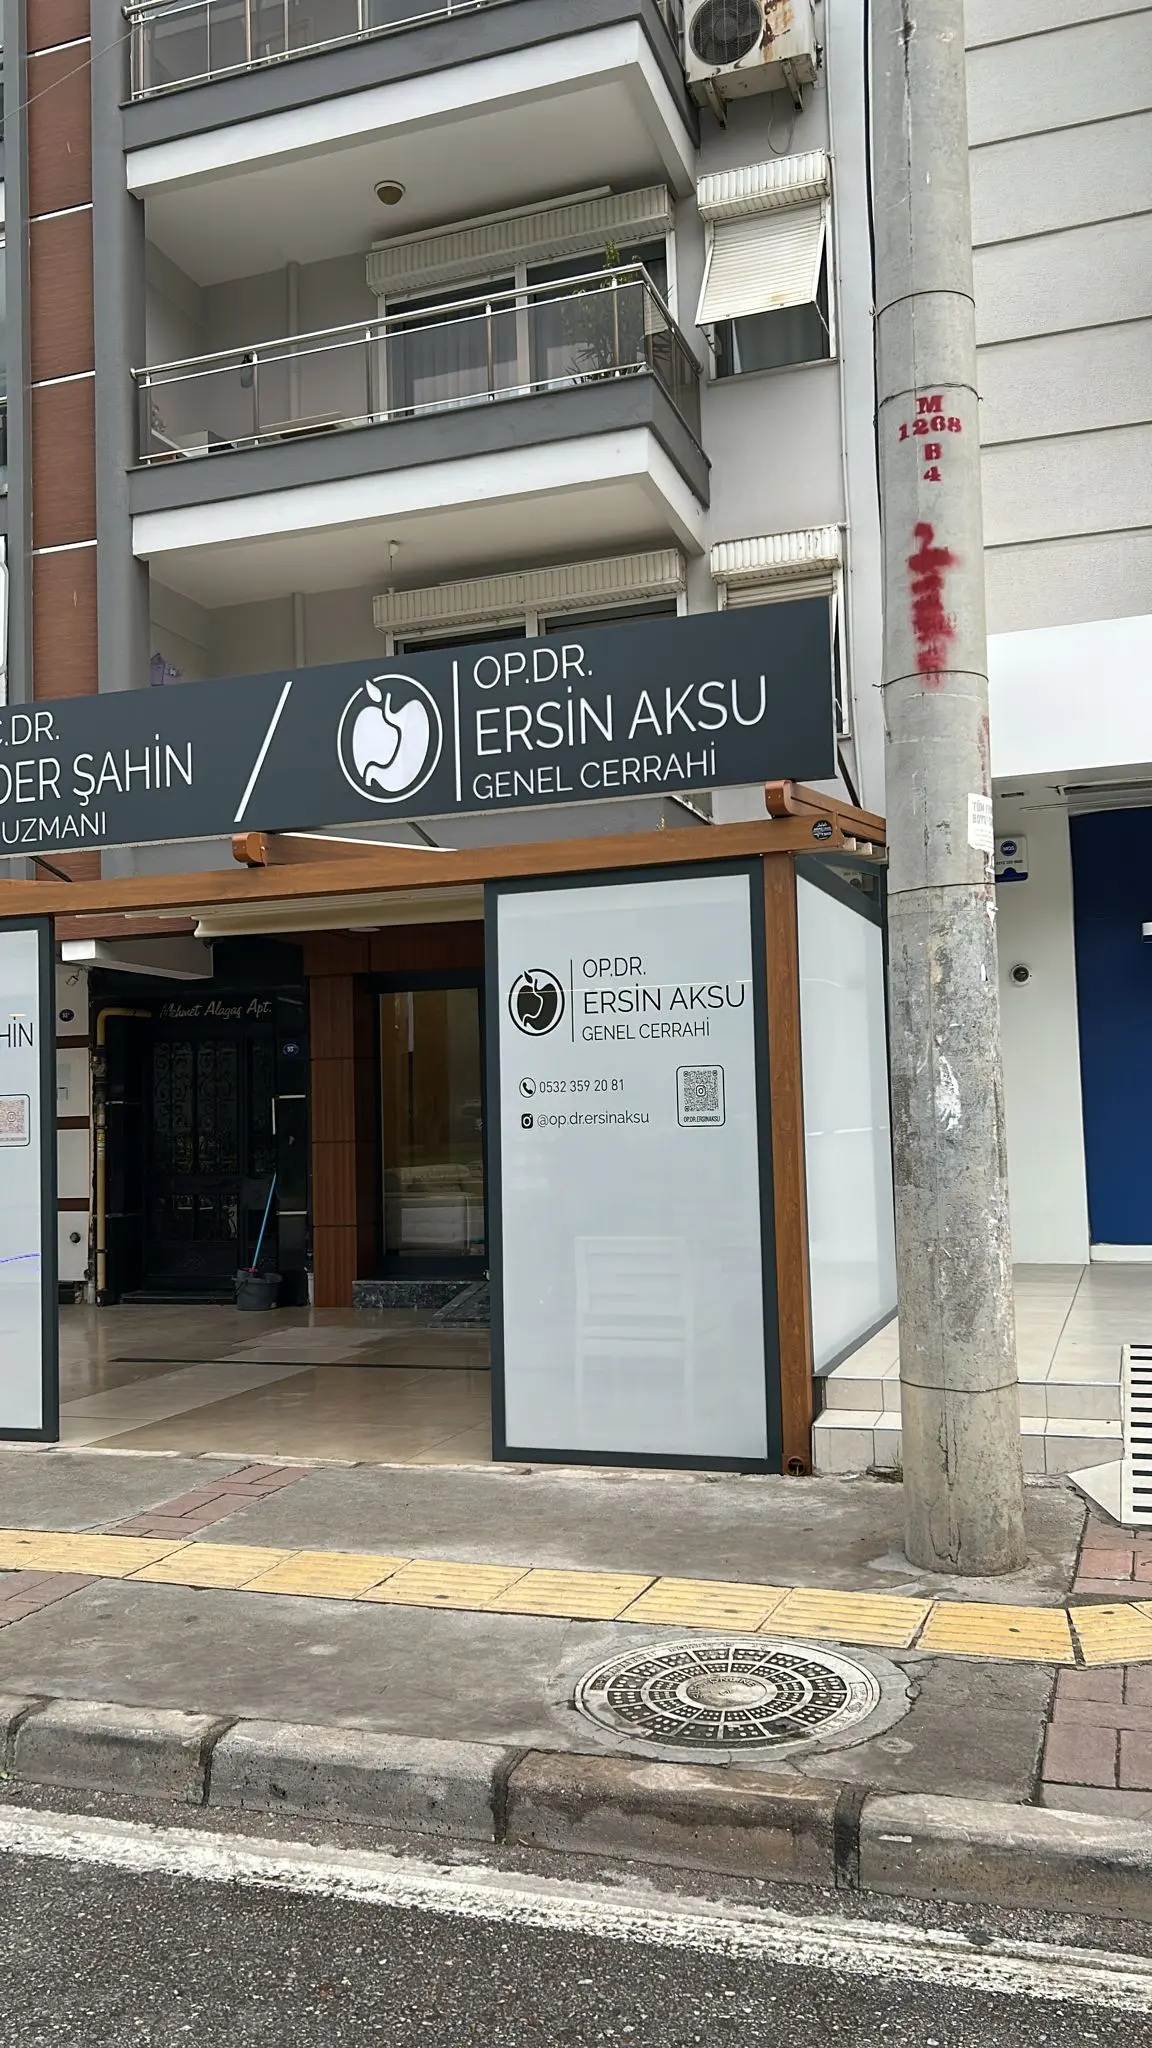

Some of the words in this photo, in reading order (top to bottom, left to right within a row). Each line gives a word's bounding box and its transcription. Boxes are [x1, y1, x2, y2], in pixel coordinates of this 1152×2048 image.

[915, 395, 944, 414] M
[898, 416, 963, 442] 1268
[923, 466, 942, 482] 4
[473, 643, 593, 690] OP.DR.
[0, 711, 60, 746] .DR.
[475, 685, 613, 757] ERSİN
[628, 675, 768, 740] AKSU
[72, 733, 193, 806] ŞAHİN
[473, 766, 573, 800] GENEL
[580, 741, 717, 788] CERRAHİ
[2, 811, 106, 844] UZMANI
[582, 956, 647, 978] OP.DR.
[246, 998, 272, 1018] Apt.
[583, 983, 661, 1014] ERSİN
[669, 984, 746, 1010] AKSU
[582, 1025, 636, 1041] GENEL
[639, 1017, 710, 1039] CERRAHİ
[539, 1081, 567, 1093] 0532
[569, 1080, 590, 1093] 359
[594, 1080, 608, 1092] 20
[611, 1079, 625, 1091] 81
[537, 1110, 650, 1129] @op.dr.ersinaksu
